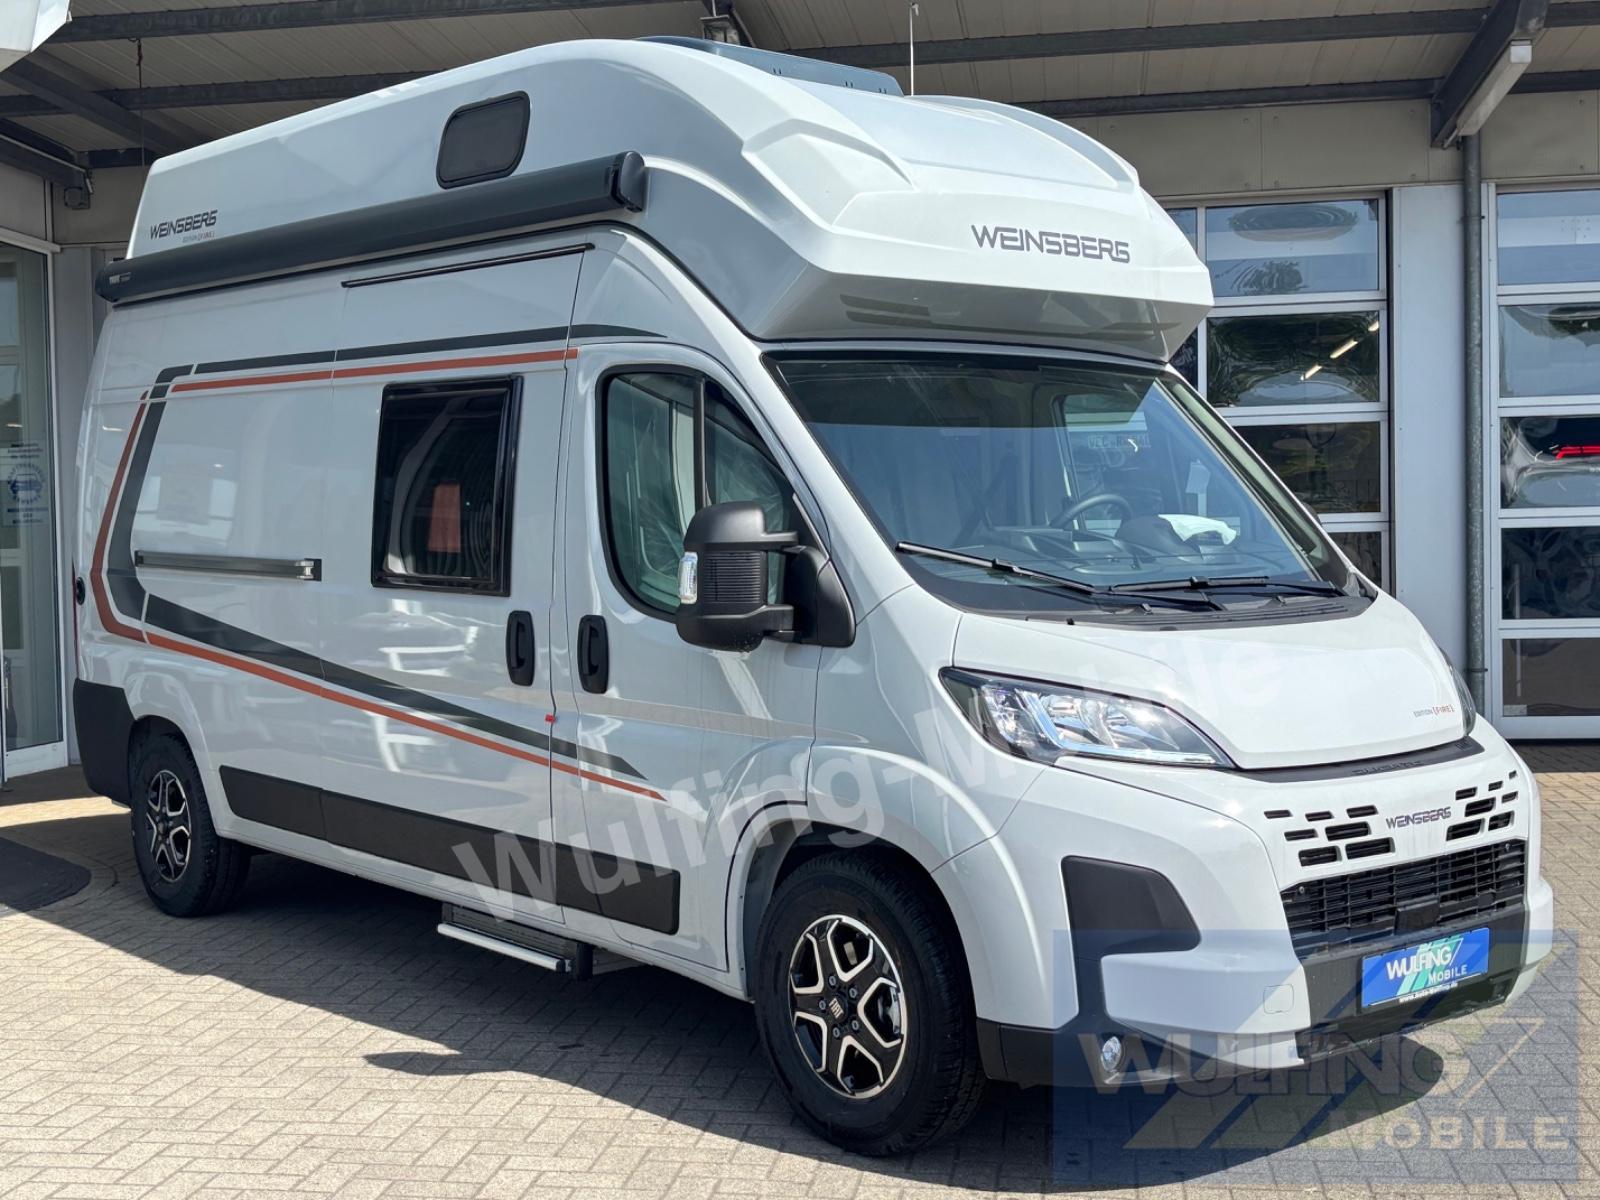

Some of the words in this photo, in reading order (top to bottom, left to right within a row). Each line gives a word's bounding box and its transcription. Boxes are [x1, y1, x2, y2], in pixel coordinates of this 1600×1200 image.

[150, 209, 218, 240] WEINSBERG
[971, 224, 1130, 264] WEINSBERG
[1385, 806, 1452, 829] WEINSBERG
[1386, 944, 1452, 980] WULFING
[1428, 964, 1468, 985] MOBILE
[829, 997, 844, 1019] FIAT
